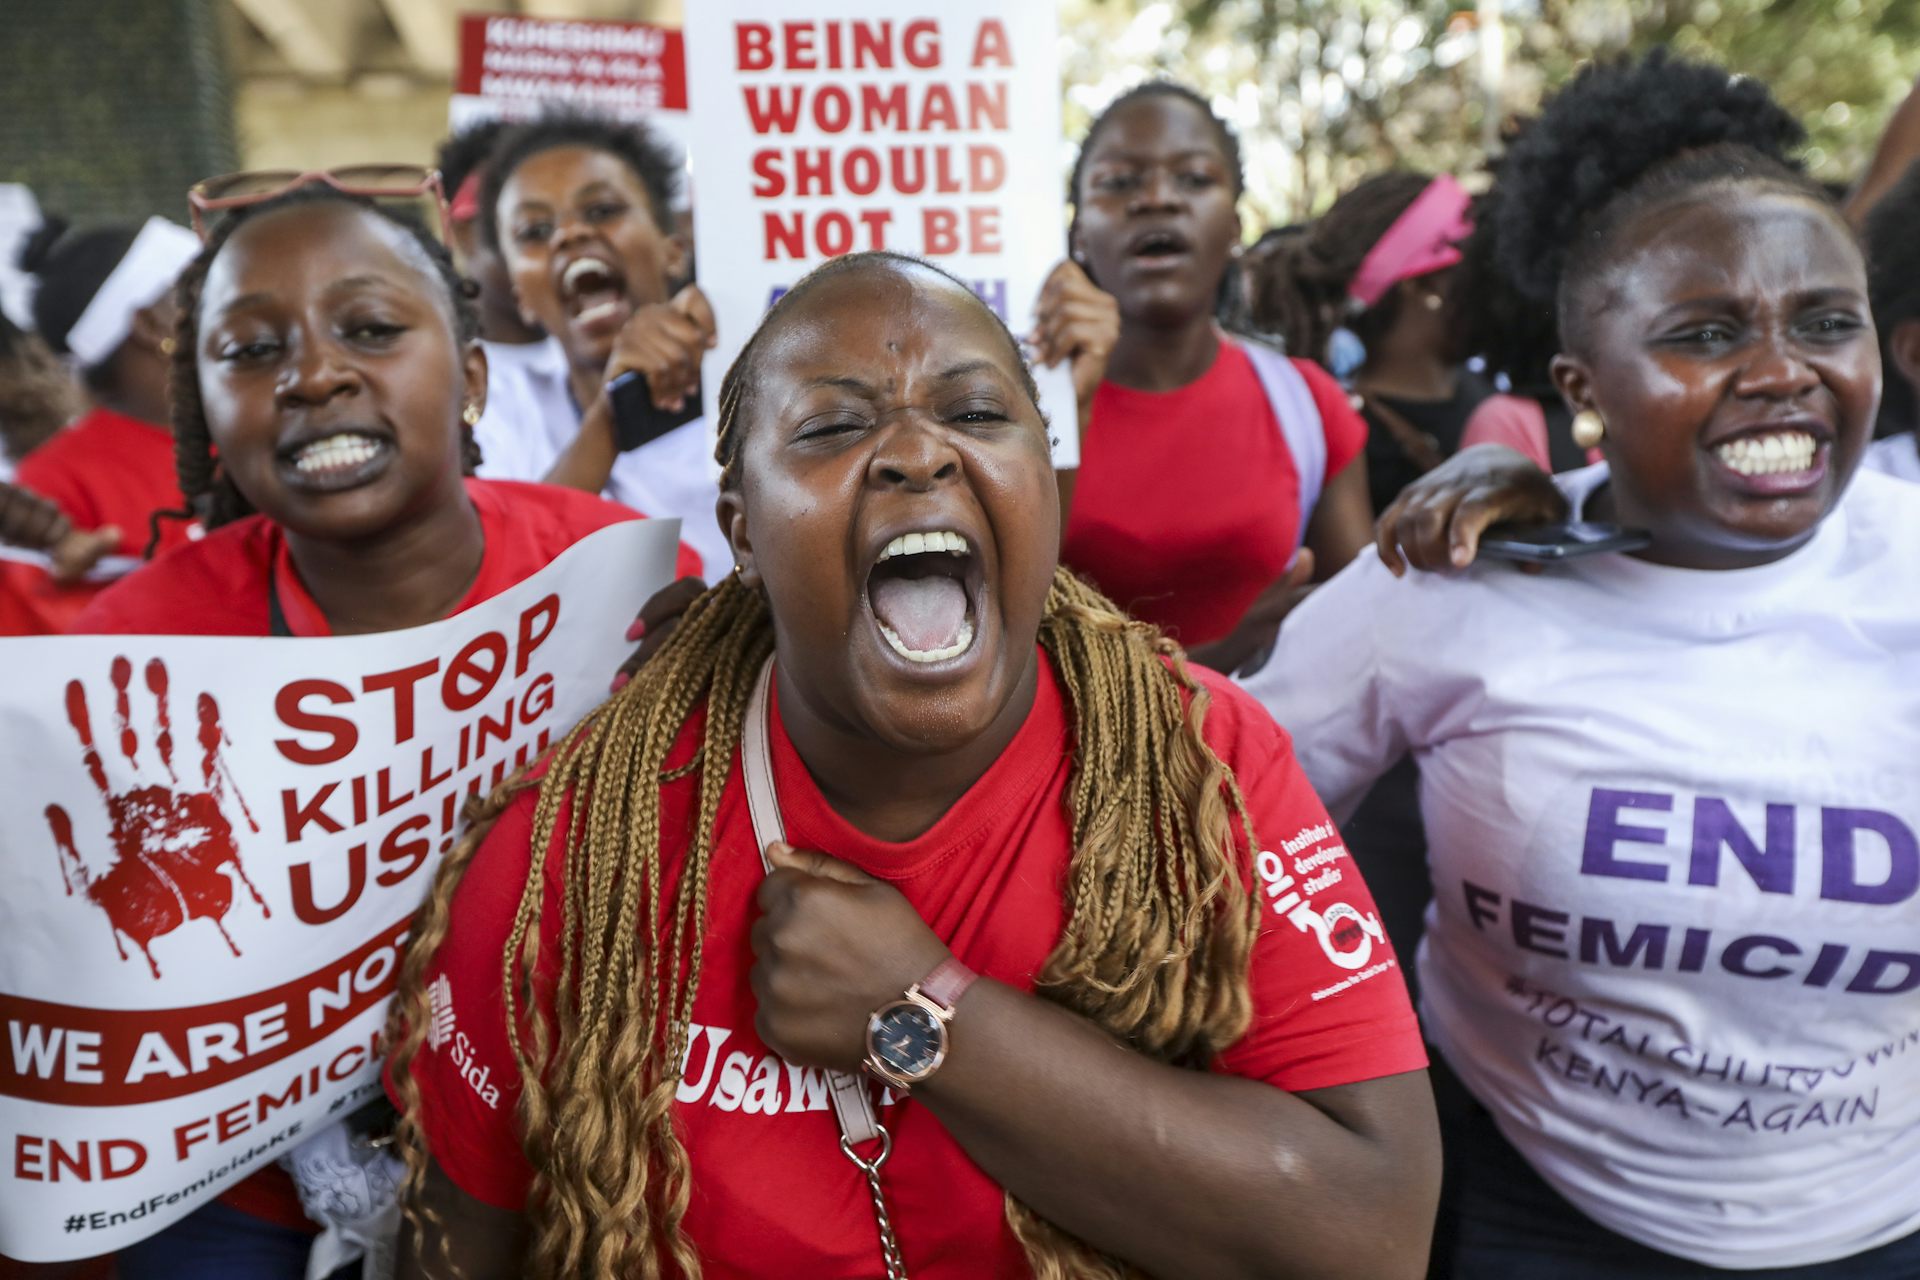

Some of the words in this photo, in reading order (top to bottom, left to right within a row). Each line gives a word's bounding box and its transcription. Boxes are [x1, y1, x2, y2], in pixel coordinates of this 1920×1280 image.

[734, 19, 941, 71] BEING
[971, 19, 1015, 68] A
[741, 82, 1010, 135] WOMAN
[751, 146, 1009, 199] SHOULD
[763, 209, 893, 260] NOT
[922, 207, 1002, 256] BE
[273, 593, 561, 766] STOP
[280, 672, 555, 844] KILLING
[1580, 787, 1920, 906] END
[1462, 878, 1920, 996] FEMICID
[8, 1020, 103, 1084] WE
[124, 1002, 289, 1084] ARE
[451, 1032, 500, 1109] Sida
[14, 1133, 148, 1184] END
[64, 1121, 304, 1235] #EndFemicideKE
